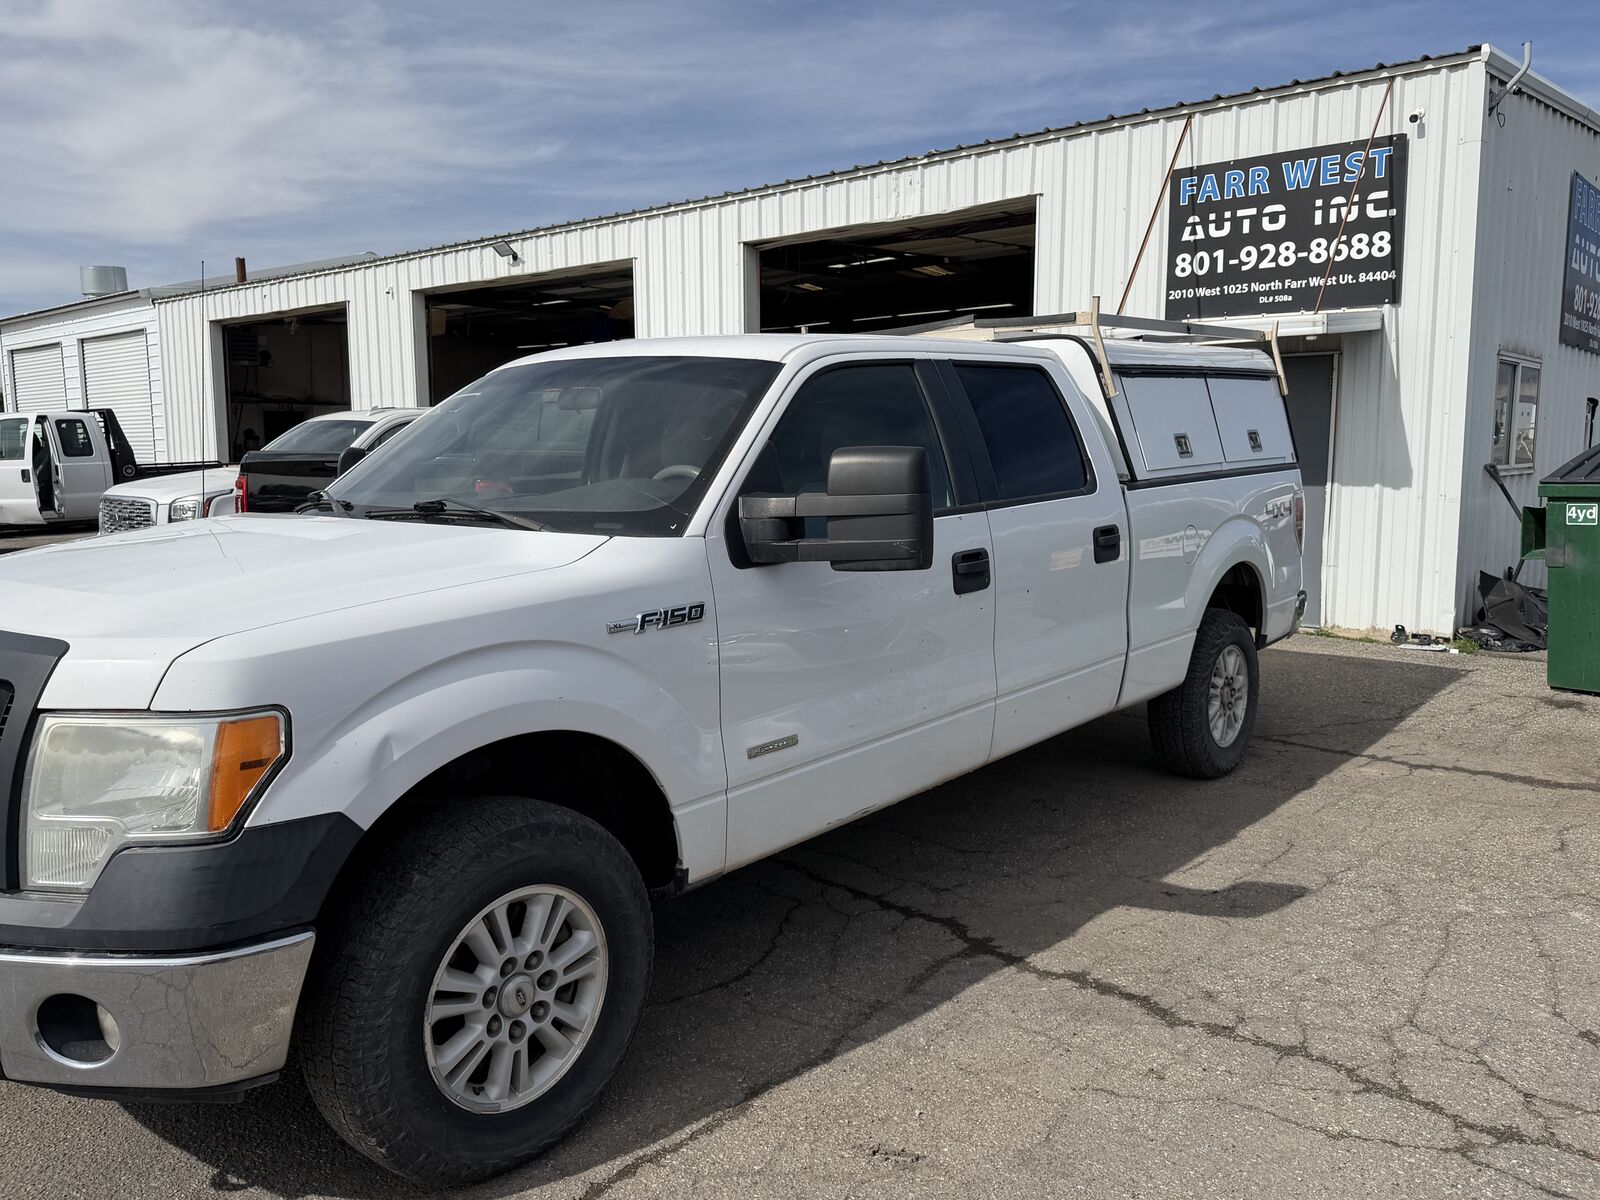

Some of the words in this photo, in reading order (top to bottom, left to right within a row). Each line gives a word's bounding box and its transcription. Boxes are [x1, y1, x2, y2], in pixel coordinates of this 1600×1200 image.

[1180, 166, 1270, 206] FARR
[1282, 146, 1394, 191] WEST
[1181, 204, 1287, 242] AUTO
[1175, 231, 1392, 278] 801-928-8688
[1168, 289, 1194, 300] 2010
[1195, 286, 1221, 298] West
[1223, 283, 1248, 295] 1025
[1250, 280, 1283, 292] North
[1284, 278, 1307, 290] Farr
[1308, 275, 1337, 287] West
[1339, 274, 1357, 284] Ut.
[1359, 270, 1397, 283] 84404
[1258, 295, 1274, 304] DL#
[1274, 294, 1293, 302] 508a
[1567, 506, 1596, 522] 4yd
